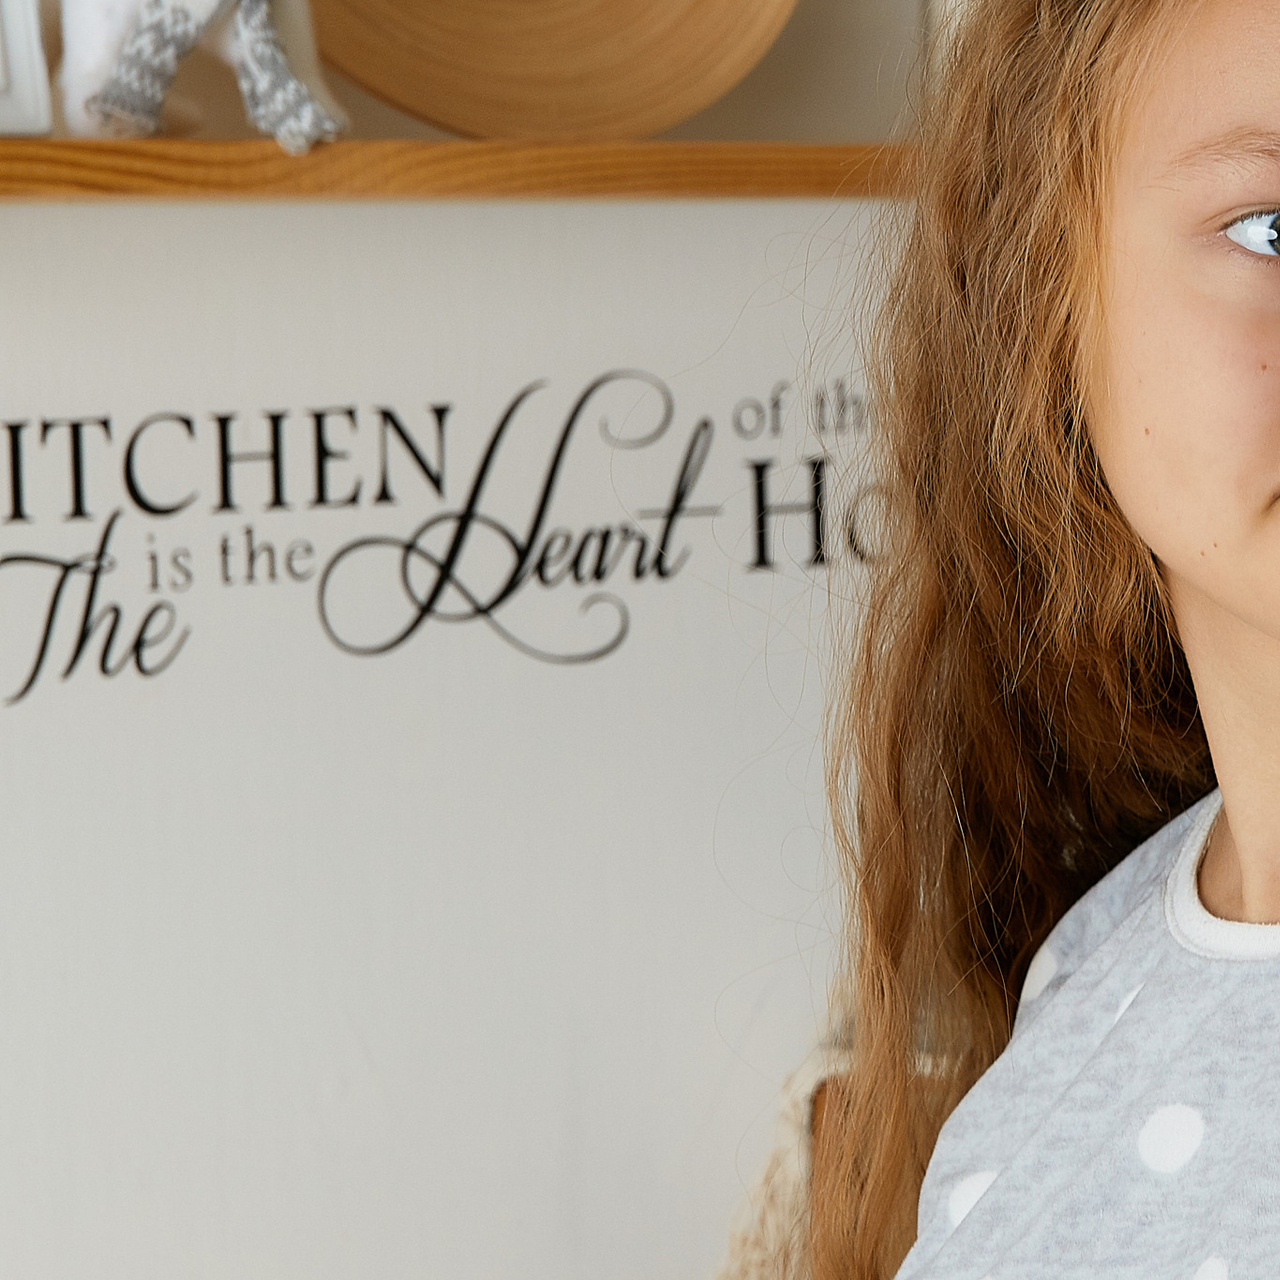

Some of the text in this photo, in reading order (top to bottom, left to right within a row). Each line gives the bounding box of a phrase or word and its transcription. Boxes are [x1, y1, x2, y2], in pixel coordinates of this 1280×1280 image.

[1, 405, 451, 522] ITCHEN
[732, 378, 872, 441] of th
[147, 524, 317, 593] is the
[318, 368, 722, 665] Heart
[0, 508, 191, 705] The
